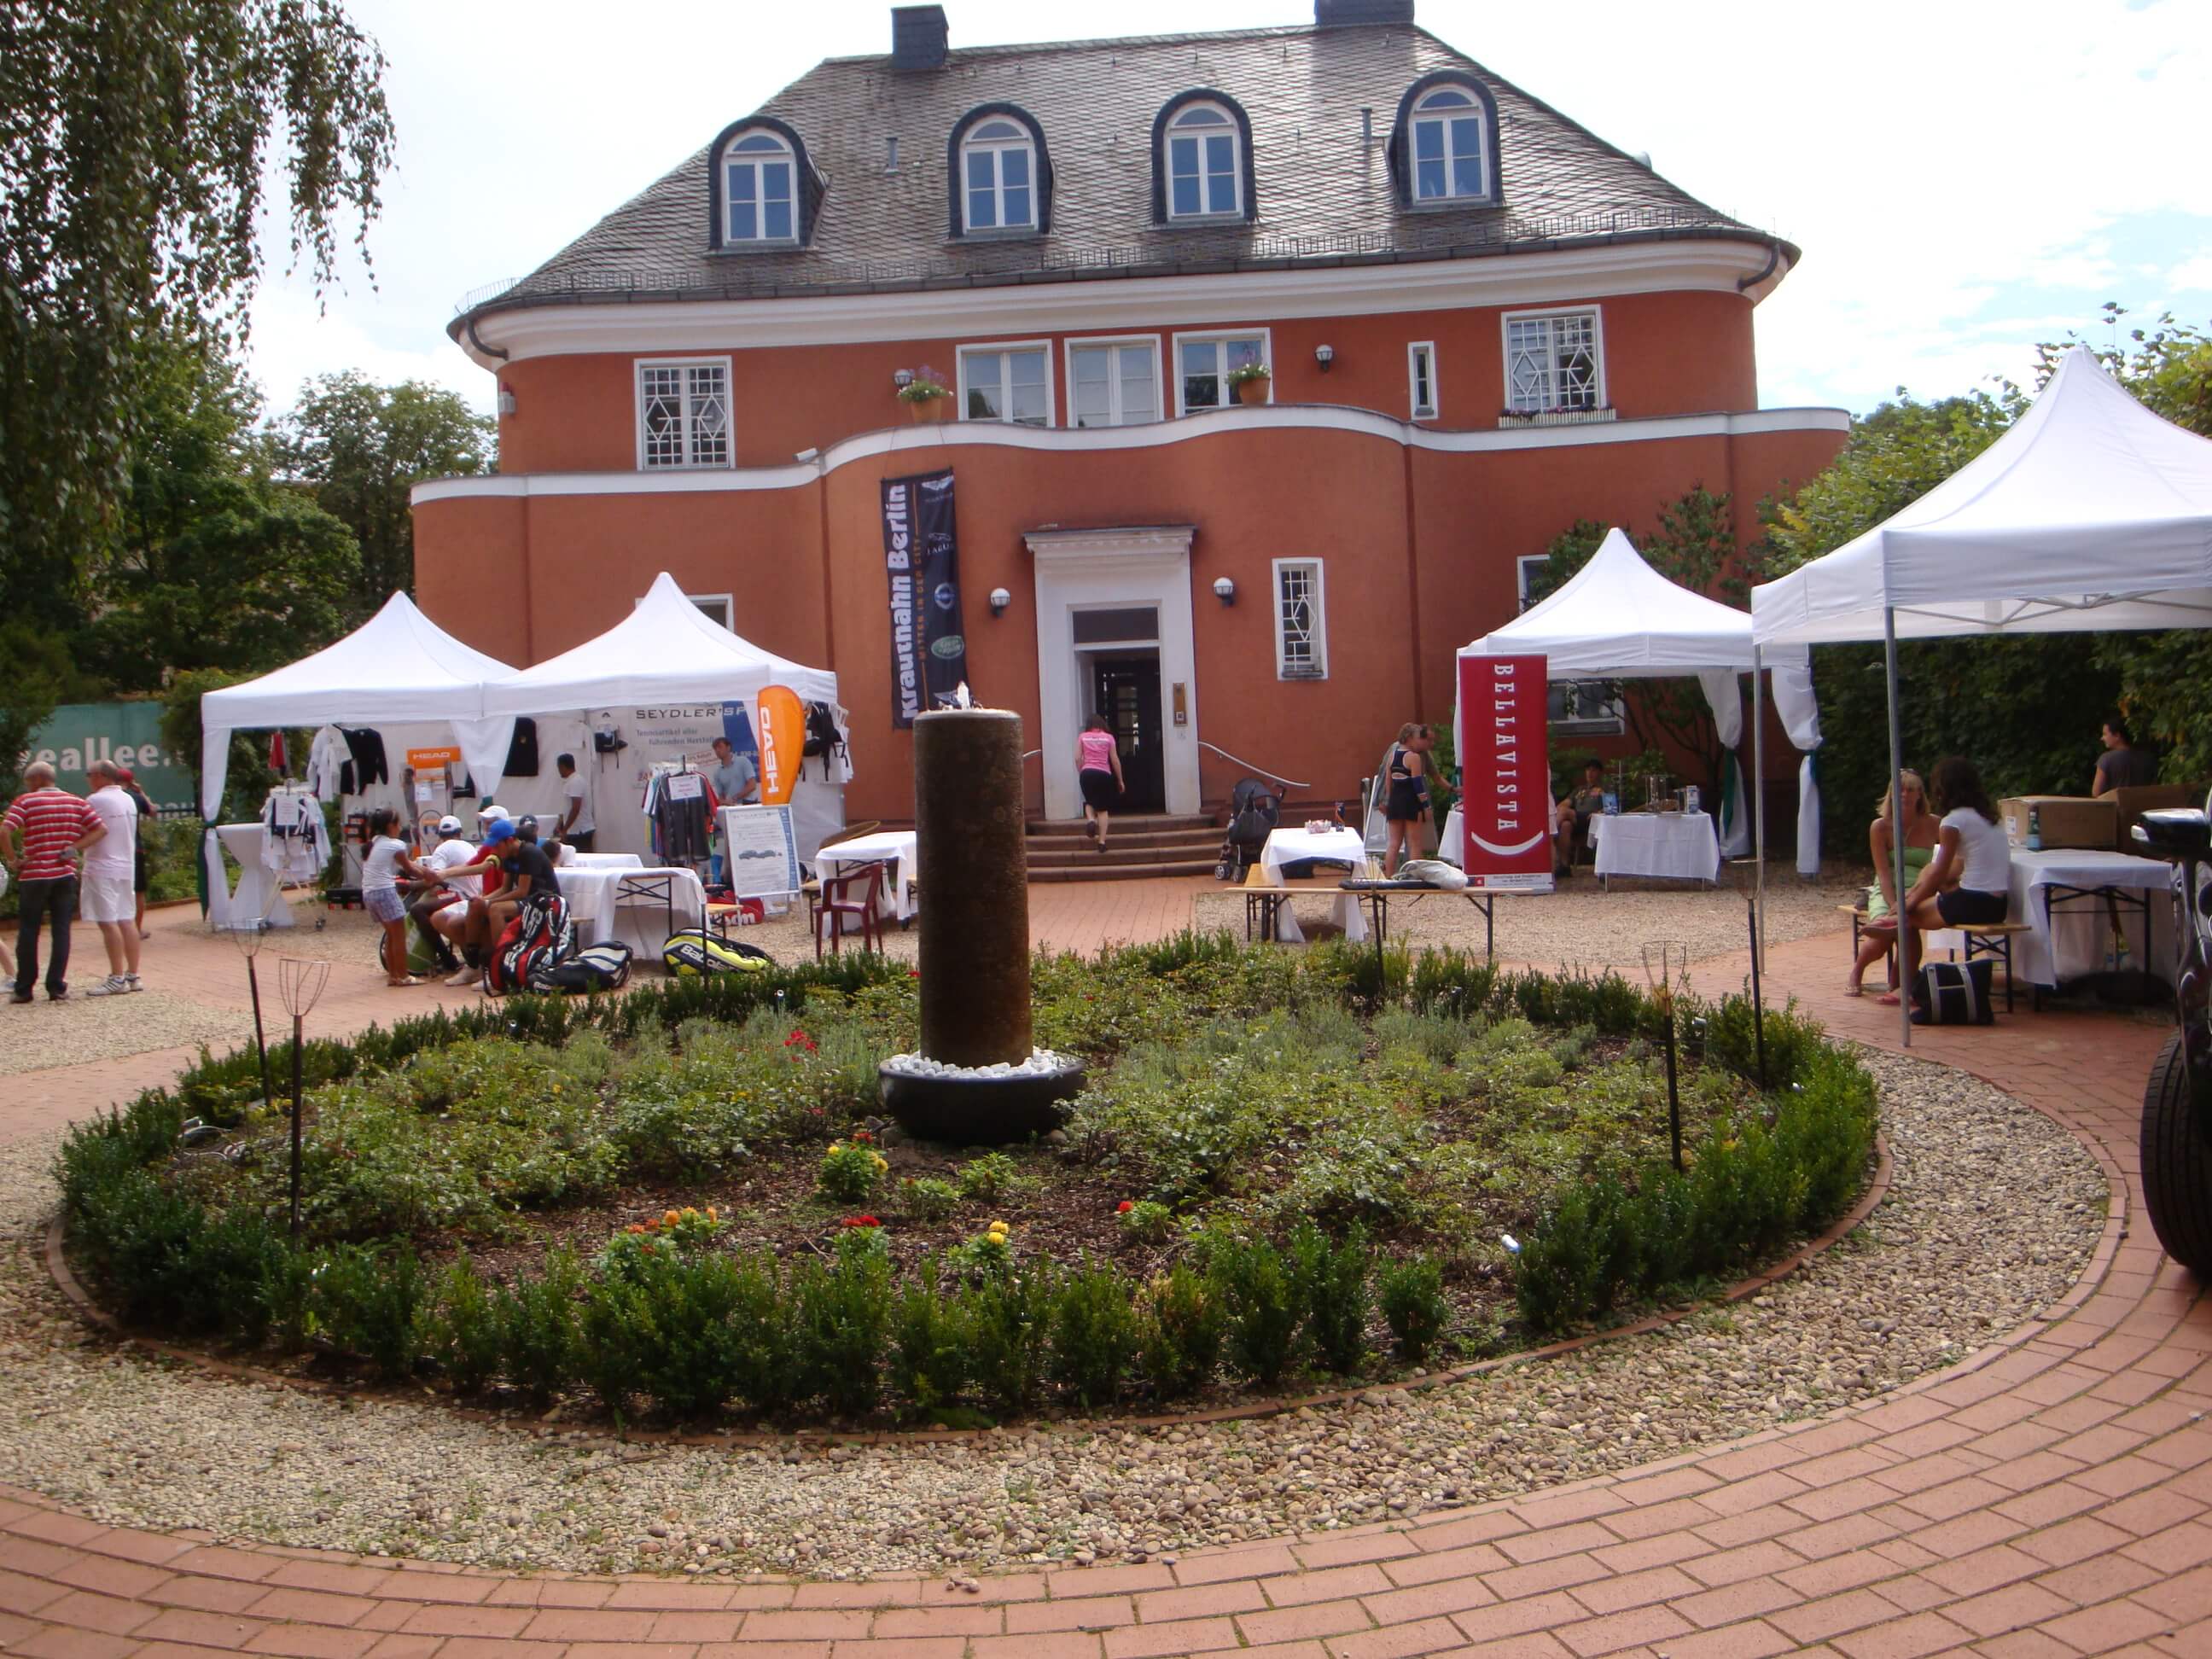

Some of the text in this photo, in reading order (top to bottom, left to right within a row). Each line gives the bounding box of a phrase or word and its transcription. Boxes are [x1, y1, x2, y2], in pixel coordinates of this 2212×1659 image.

[886, 484, 910, 568] Berlin
[413, 751, 451, 760] HEAD
[760, 707, 779, 793] HEAD
[1494, 664, 1517, 830] BELLAVISTA
